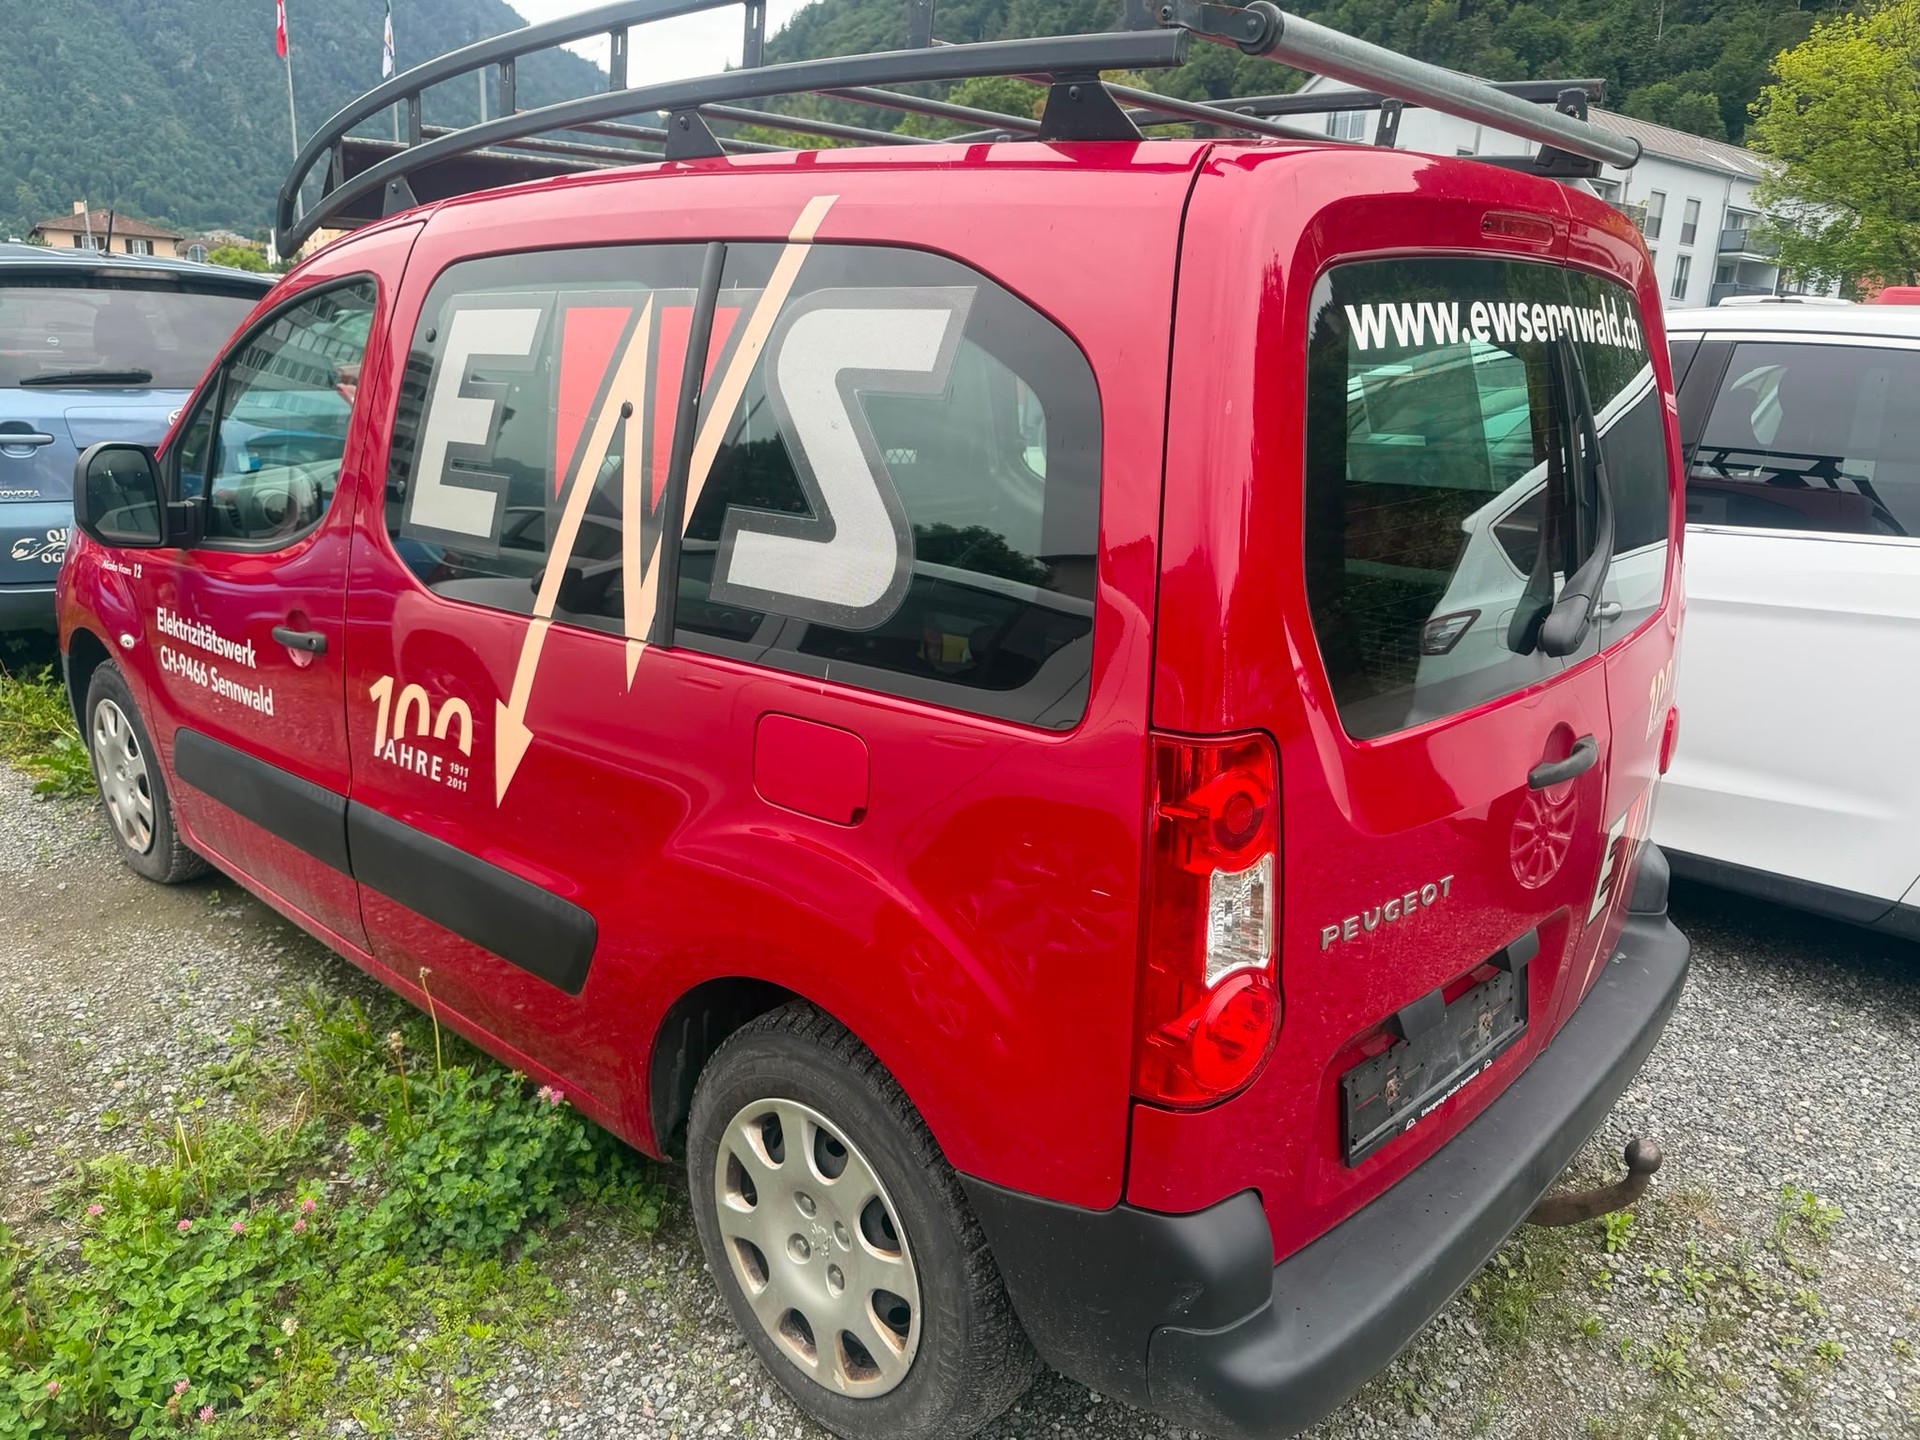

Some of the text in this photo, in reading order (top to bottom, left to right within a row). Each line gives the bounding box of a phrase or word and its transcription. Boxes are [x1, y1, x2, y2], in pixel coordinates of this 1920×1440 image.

[1344, 294, 1642, 351] www.ewsennwald.ch
[133, 563, 142, 579] 12
[156, 606, 257, 668] Elektrizitätswerk
[160, 645, 275, 717] CH-9466 Sennwald
[369, 675, 473, 757] 100
[446, 775, 467, 792] 2011
[449, 762, 469, 778] 1911
[1320, 874, 1455, 951] PEUGEOT
